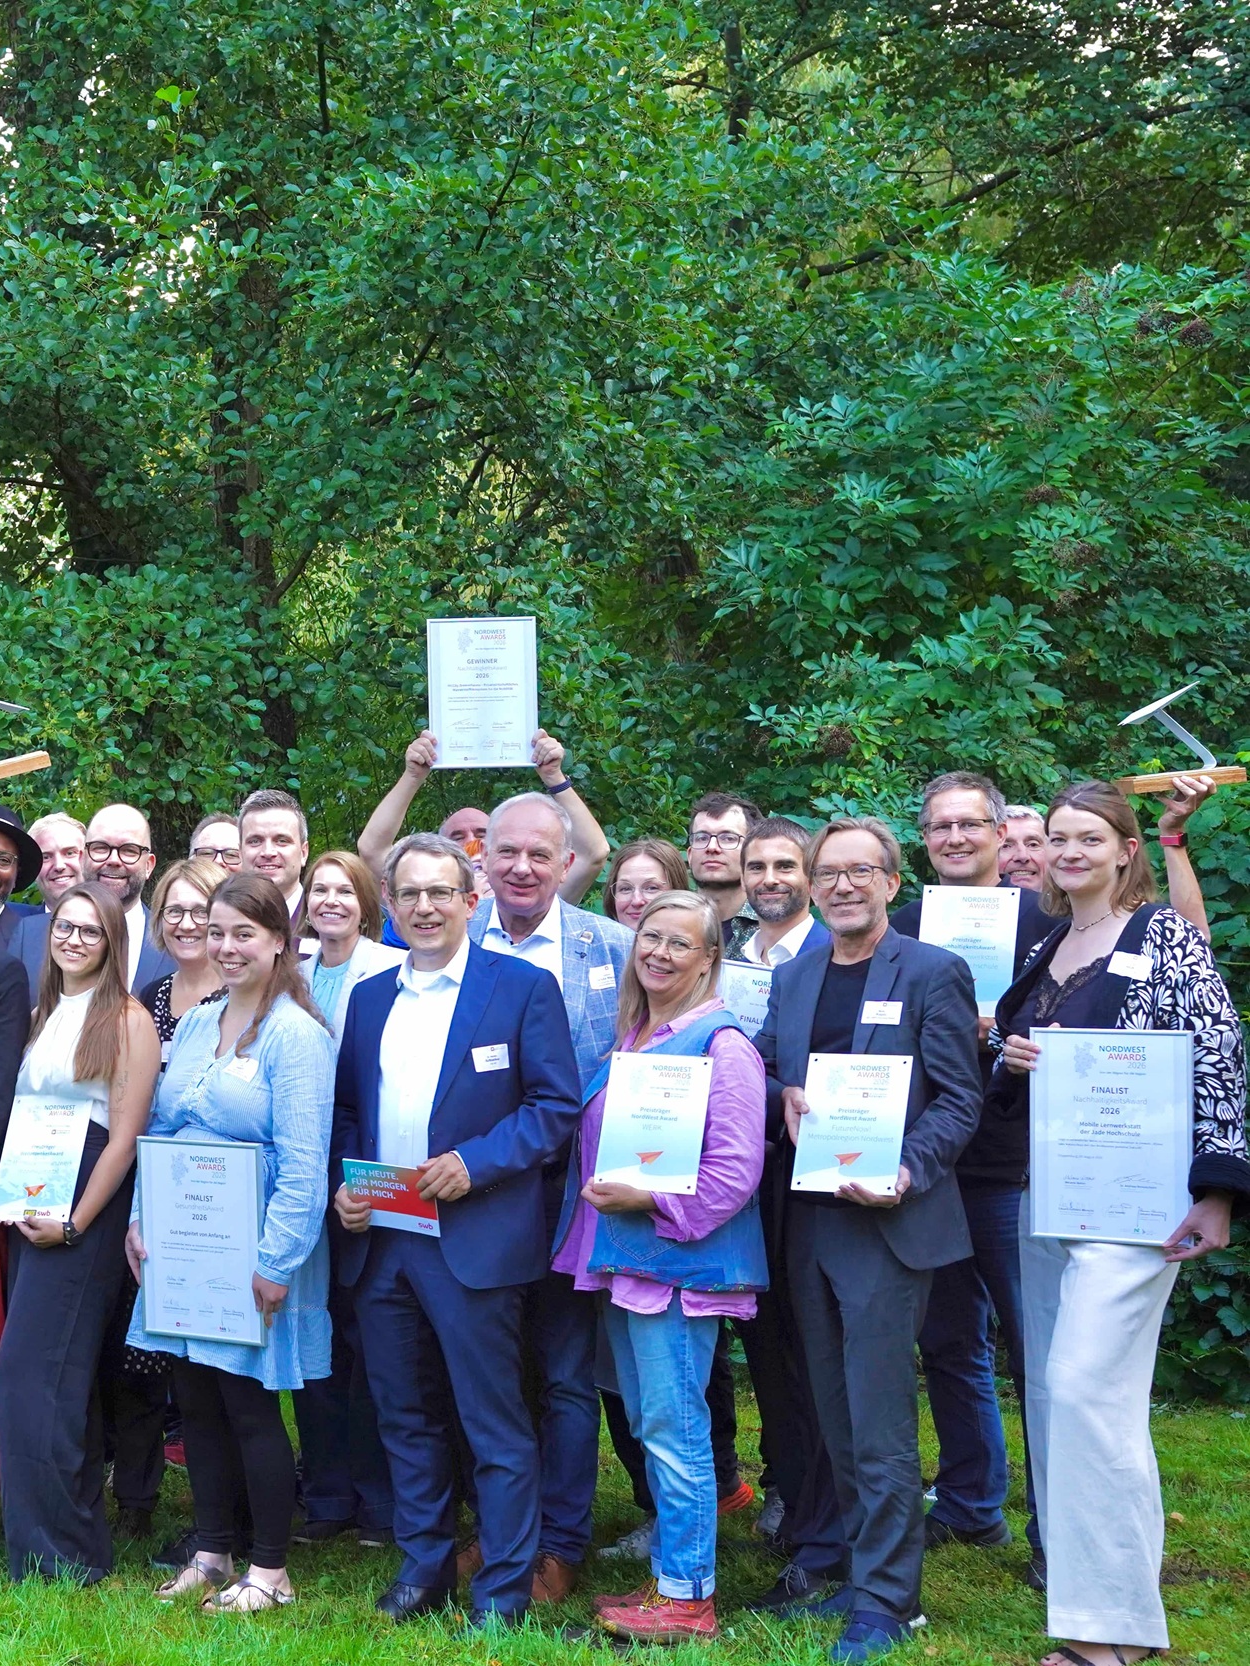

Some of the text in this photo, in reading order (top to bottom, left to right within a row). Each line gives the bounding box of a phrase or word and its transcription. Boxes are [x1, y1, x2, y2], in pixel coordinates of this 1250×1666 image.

[1073, 1096, 1147, 1104] NachhaltigkeitsAward
[350, 1166, 399, 1180] FÜR HEUTE.
[352, 1176, 409, 1192] FÜR MORGEN.
[185, 1194, 213, 1202] FINALIST
[353, 1186, 396, 1199] FÜR MICH.
[175, 1203, 224, 1212] GesundheitsAward
